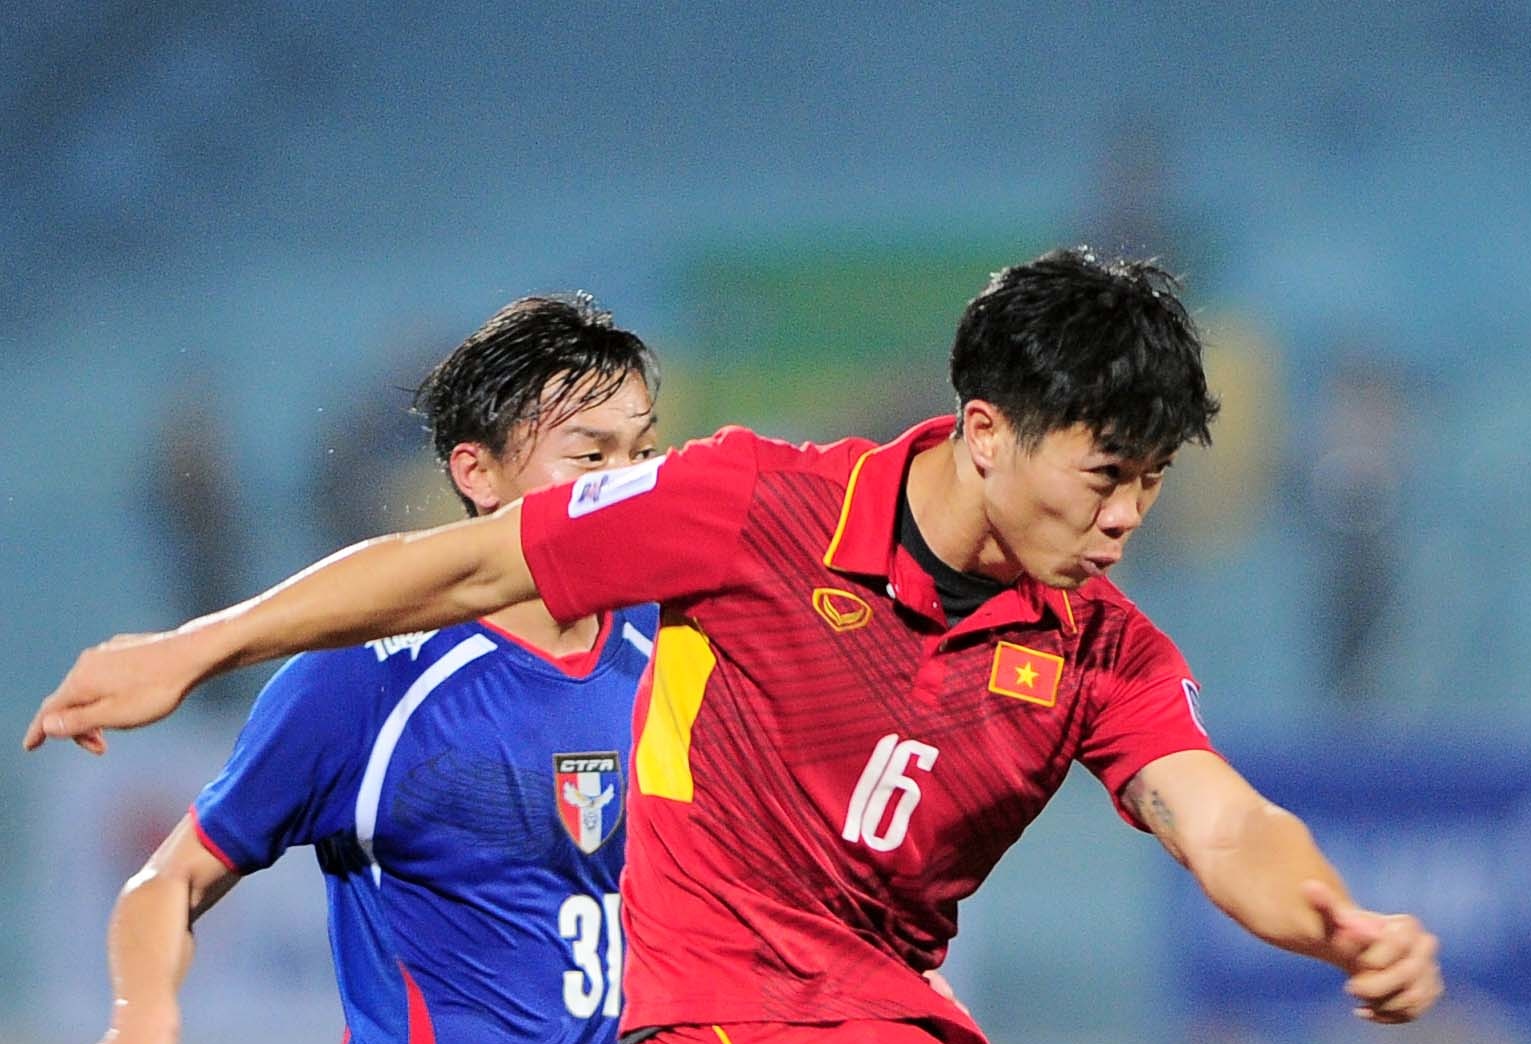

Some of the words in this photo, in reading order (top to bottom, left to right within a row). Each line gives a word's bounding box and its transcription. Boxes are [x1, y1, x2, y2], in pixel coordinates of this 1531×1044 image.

[560, 759, 615, 773] CTFA
[842, 733, 940, 852] 16
[559, 893, 622, 1018] 31
